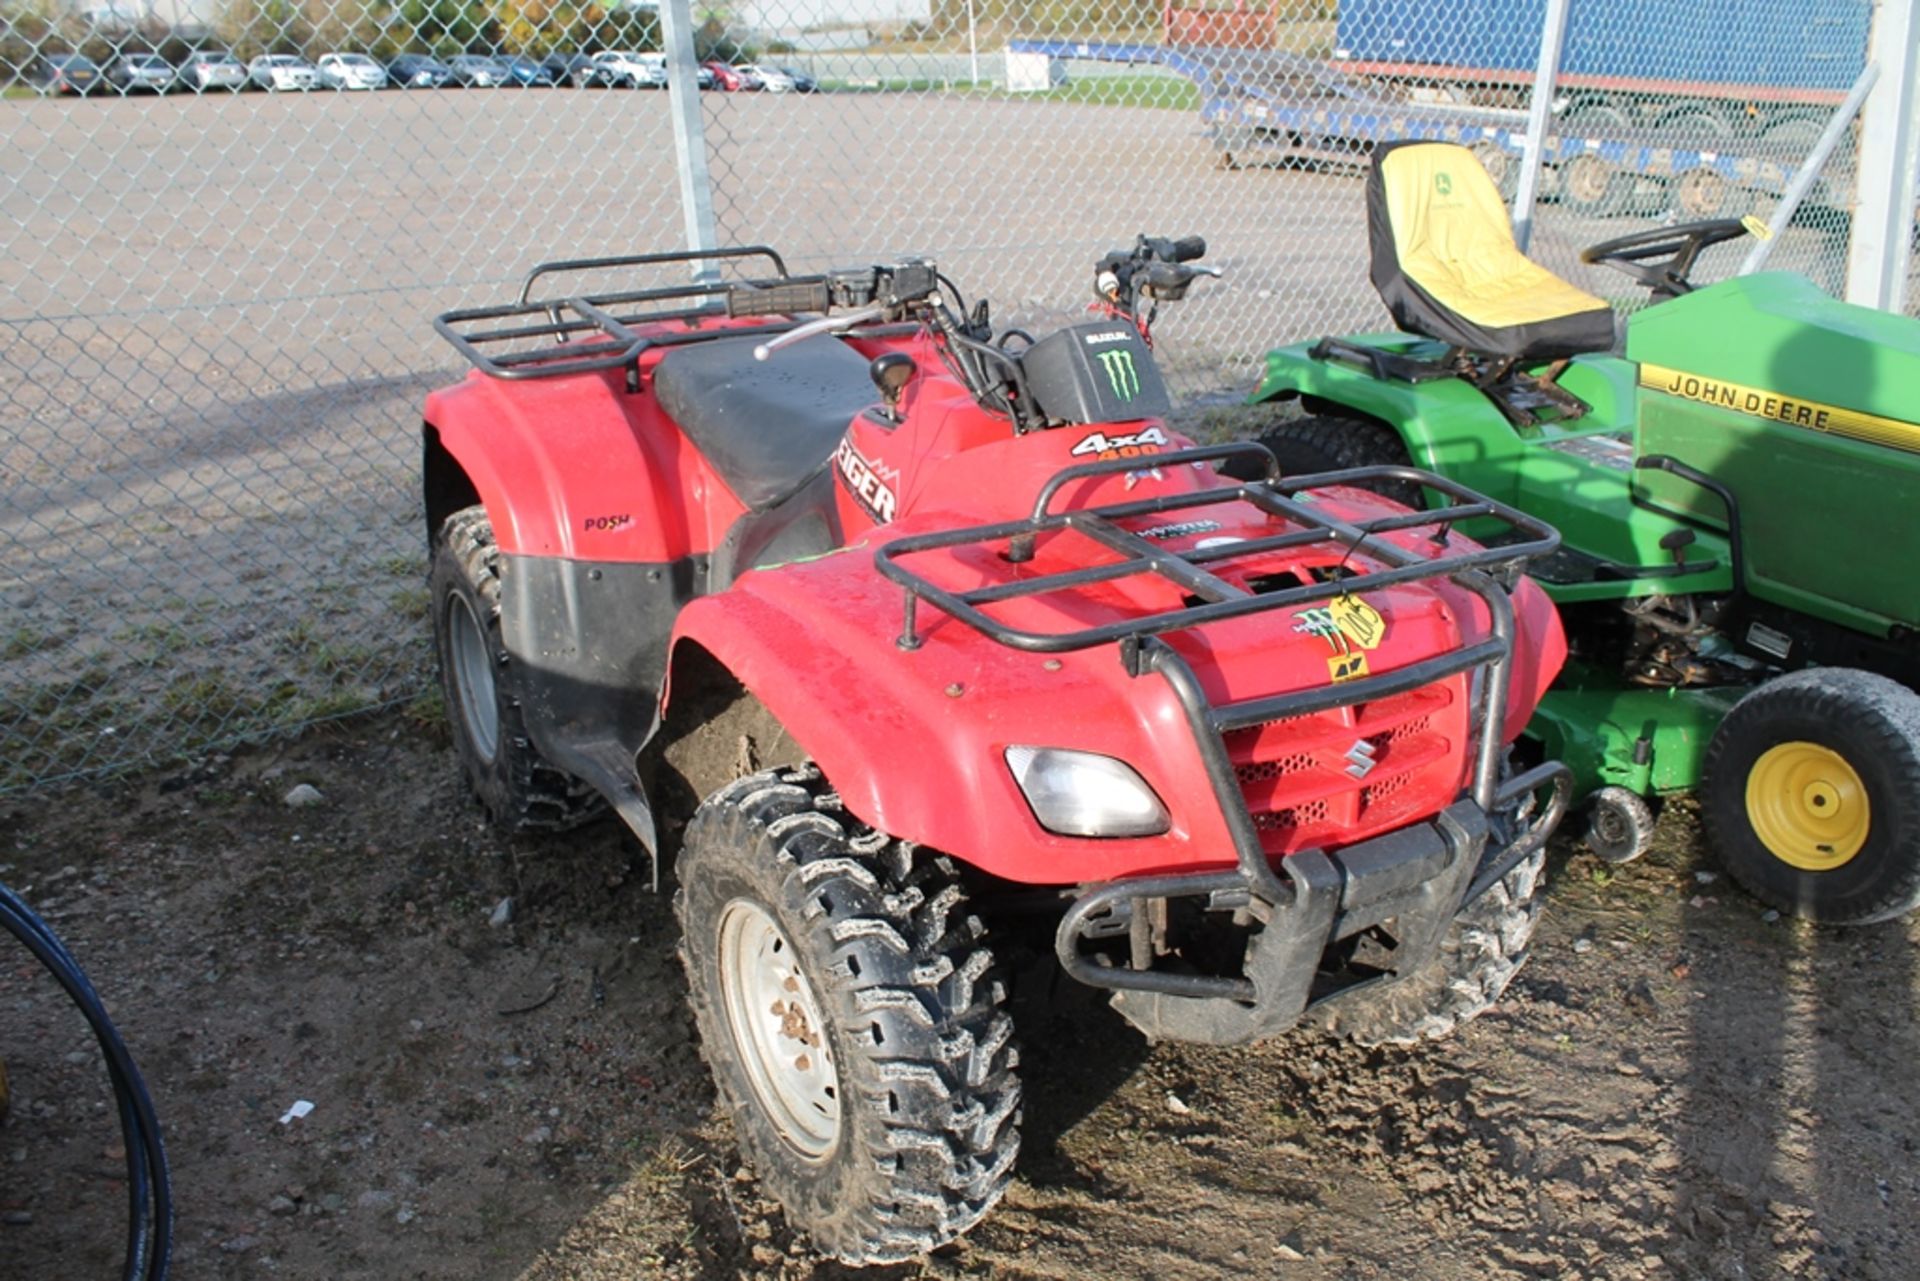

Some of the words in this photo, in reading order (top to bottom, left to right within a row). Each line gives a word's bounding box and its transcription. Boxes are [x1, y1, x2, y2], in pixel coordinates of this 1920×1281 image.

[1668, 375, 1737, 406] JOHN
[1744, 393, 1830, 430] DEERE
[1098, 443, 1159, 461] 400
[837, 437, 896, 524] EIGER
[584, 514, 630, 532] POSH
